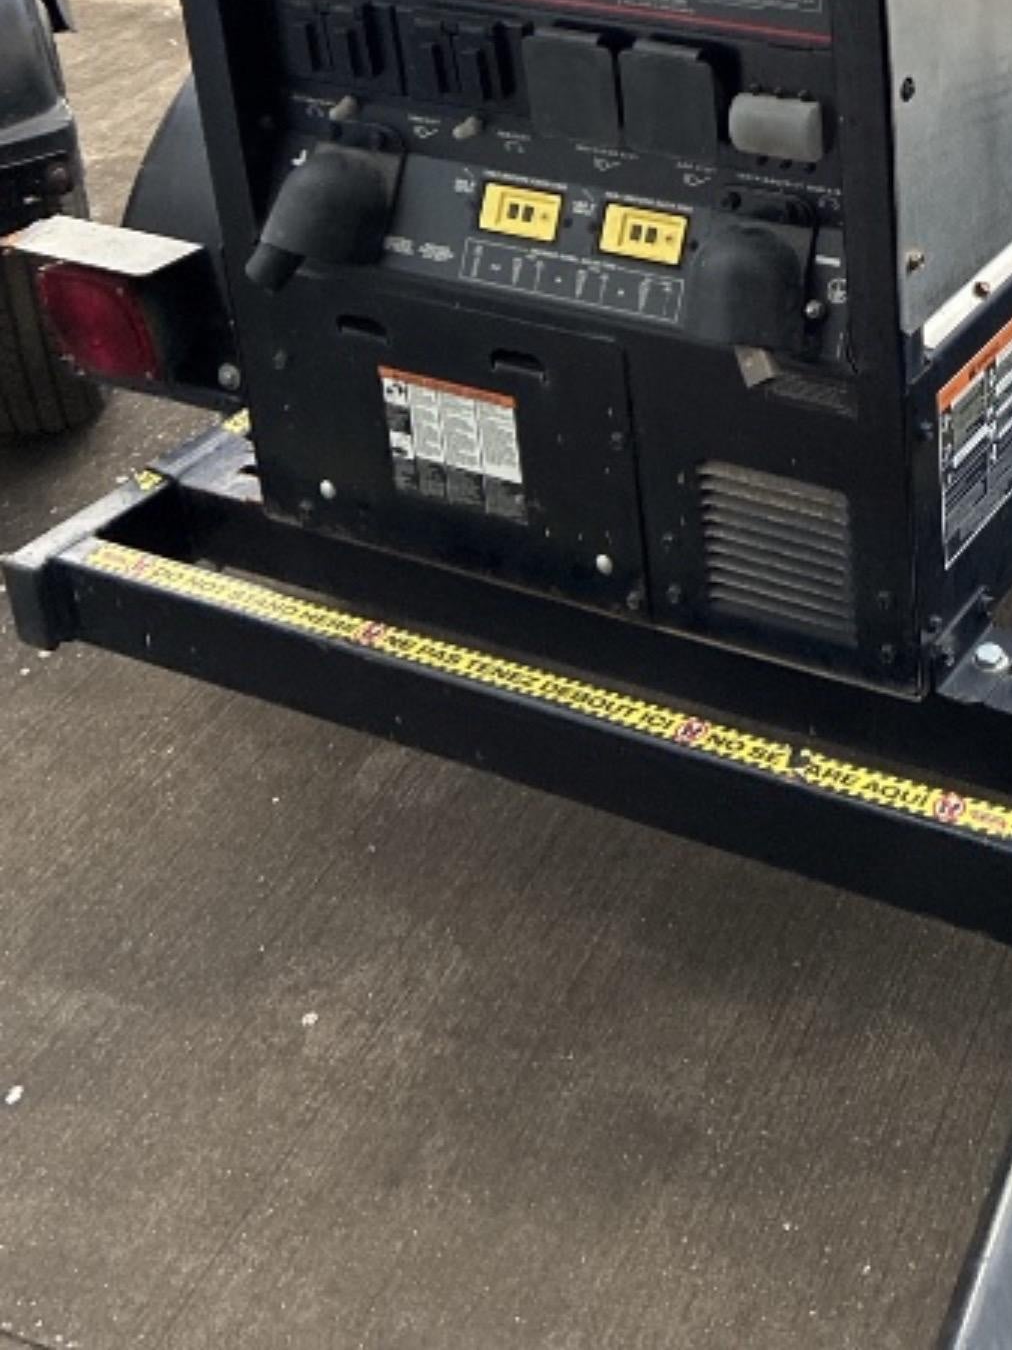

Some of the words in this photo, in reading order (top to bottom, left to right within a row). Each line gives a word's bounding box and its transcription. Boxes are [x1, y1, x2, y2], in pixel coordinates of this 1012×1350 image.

[300, 610, 356, 633] HERE
[385, 632, 411, 652] NE
[416, 642, 462, 667] PAS
[464, 656, 541, 687] TENEZ
[539, 679, 637, 717] DEBOUT
[638, 707, 676, 729] ICI
[706, 731, 744, 752] NO
[749, 743, 782, 764] SE
[801, 762, 862, 788] ARE
